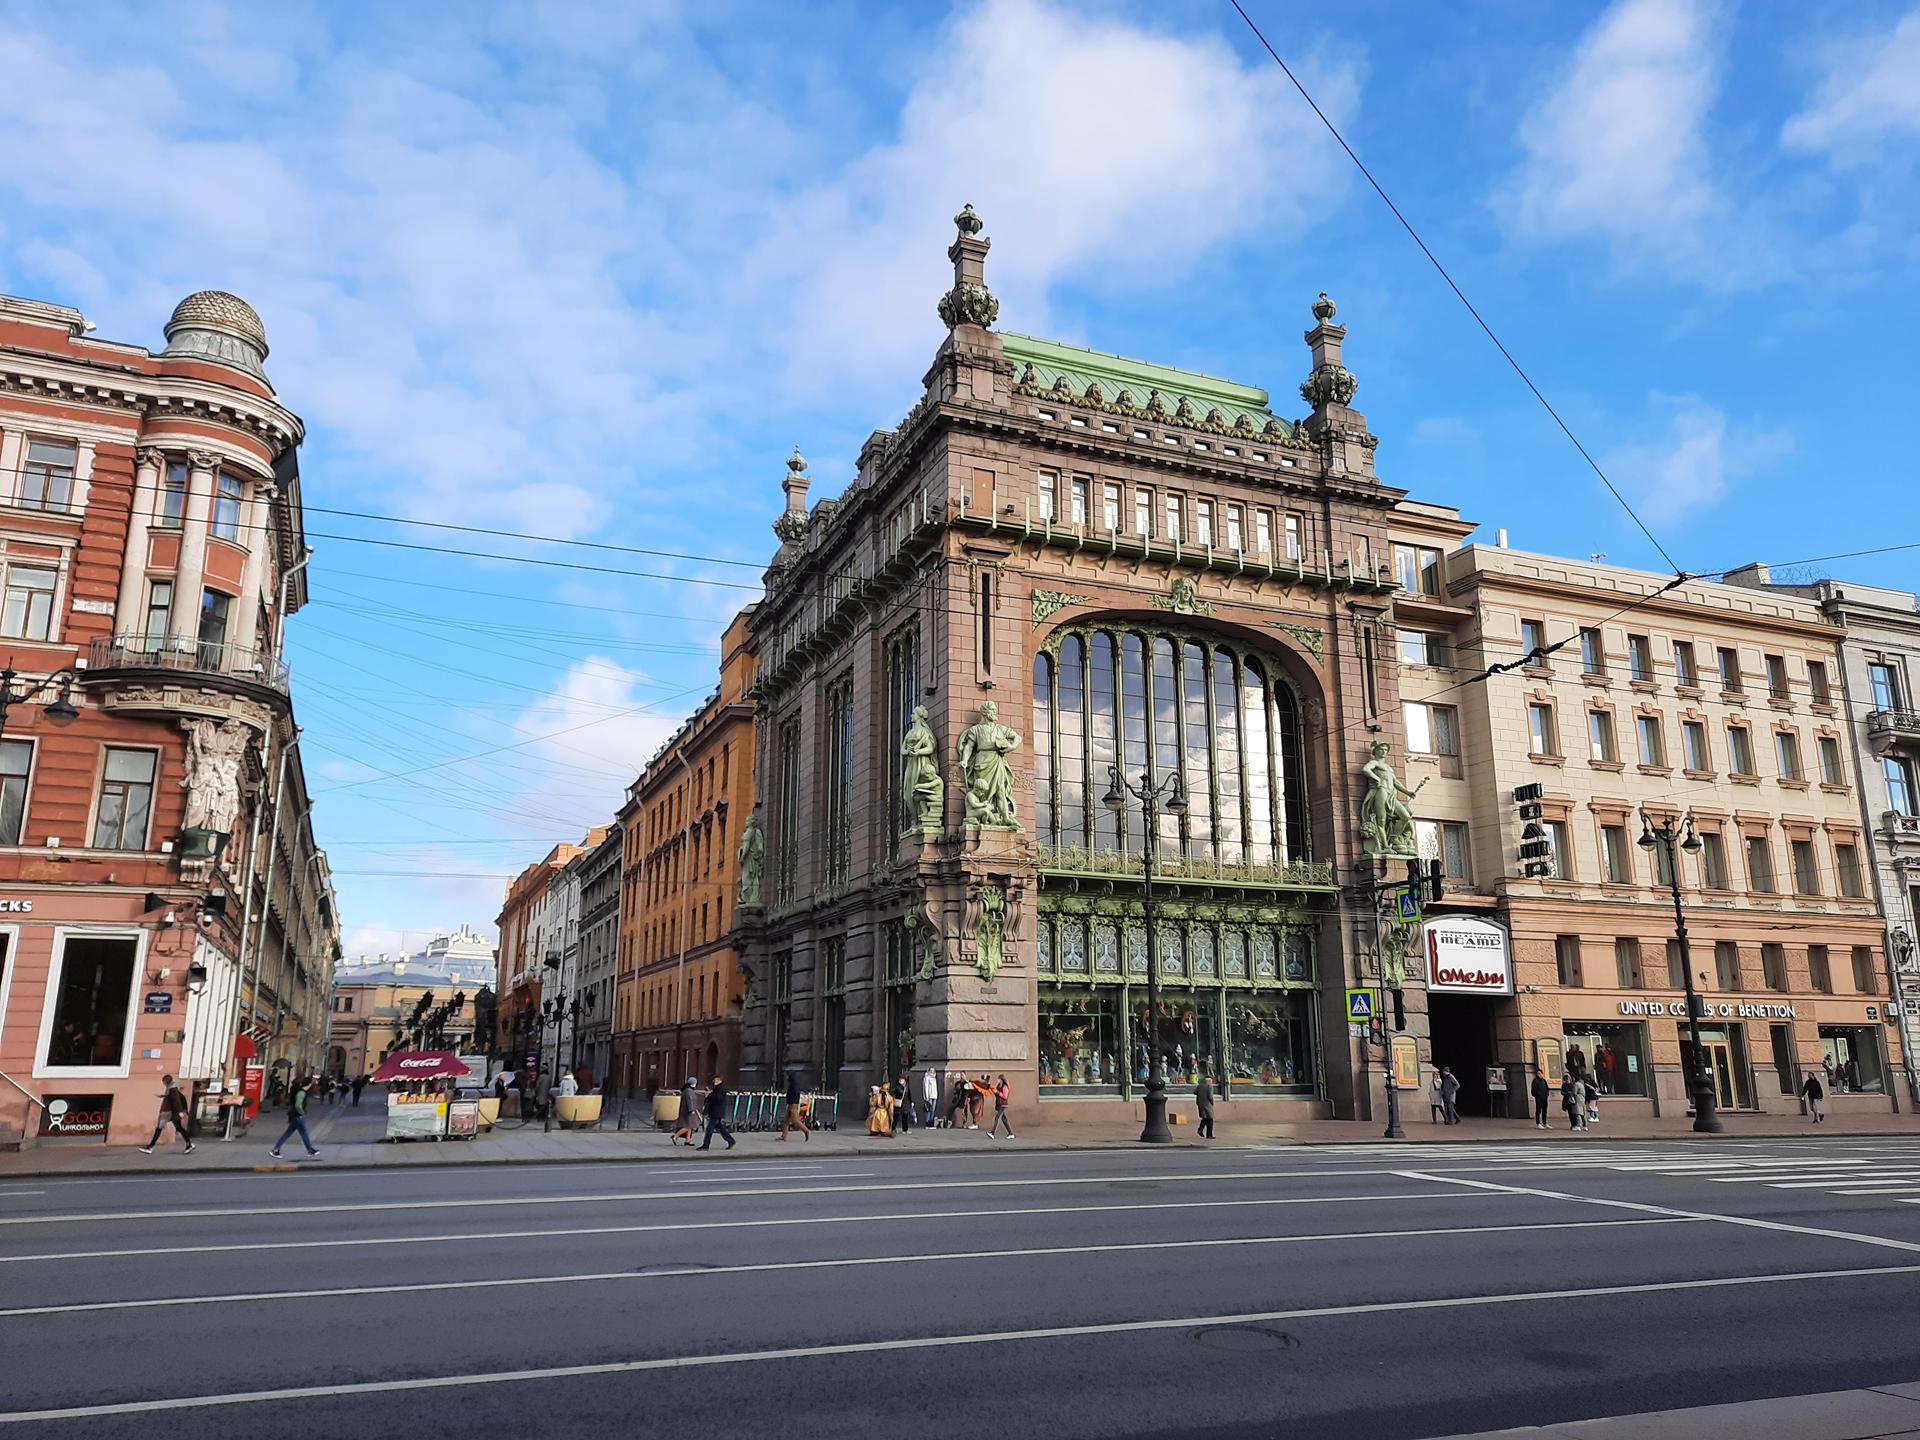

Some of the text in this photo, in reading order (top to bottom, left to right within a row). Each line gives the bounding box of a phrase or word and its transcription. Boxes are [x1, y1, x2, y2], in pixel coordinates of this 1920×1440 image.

[0, 900, 32, 912] CKS
[1441, 936, 1501, 946] ТЕАТР
[1428, 929, 1505, 988] Комедии
[1621, 1001, 1664, 1015] UNITED
[1719, 1003, 1734, 1016] OF
[1738, 1004, 1796, 1017] BENETTON
[400, 1058, 442, 1067] Coca-Cola
